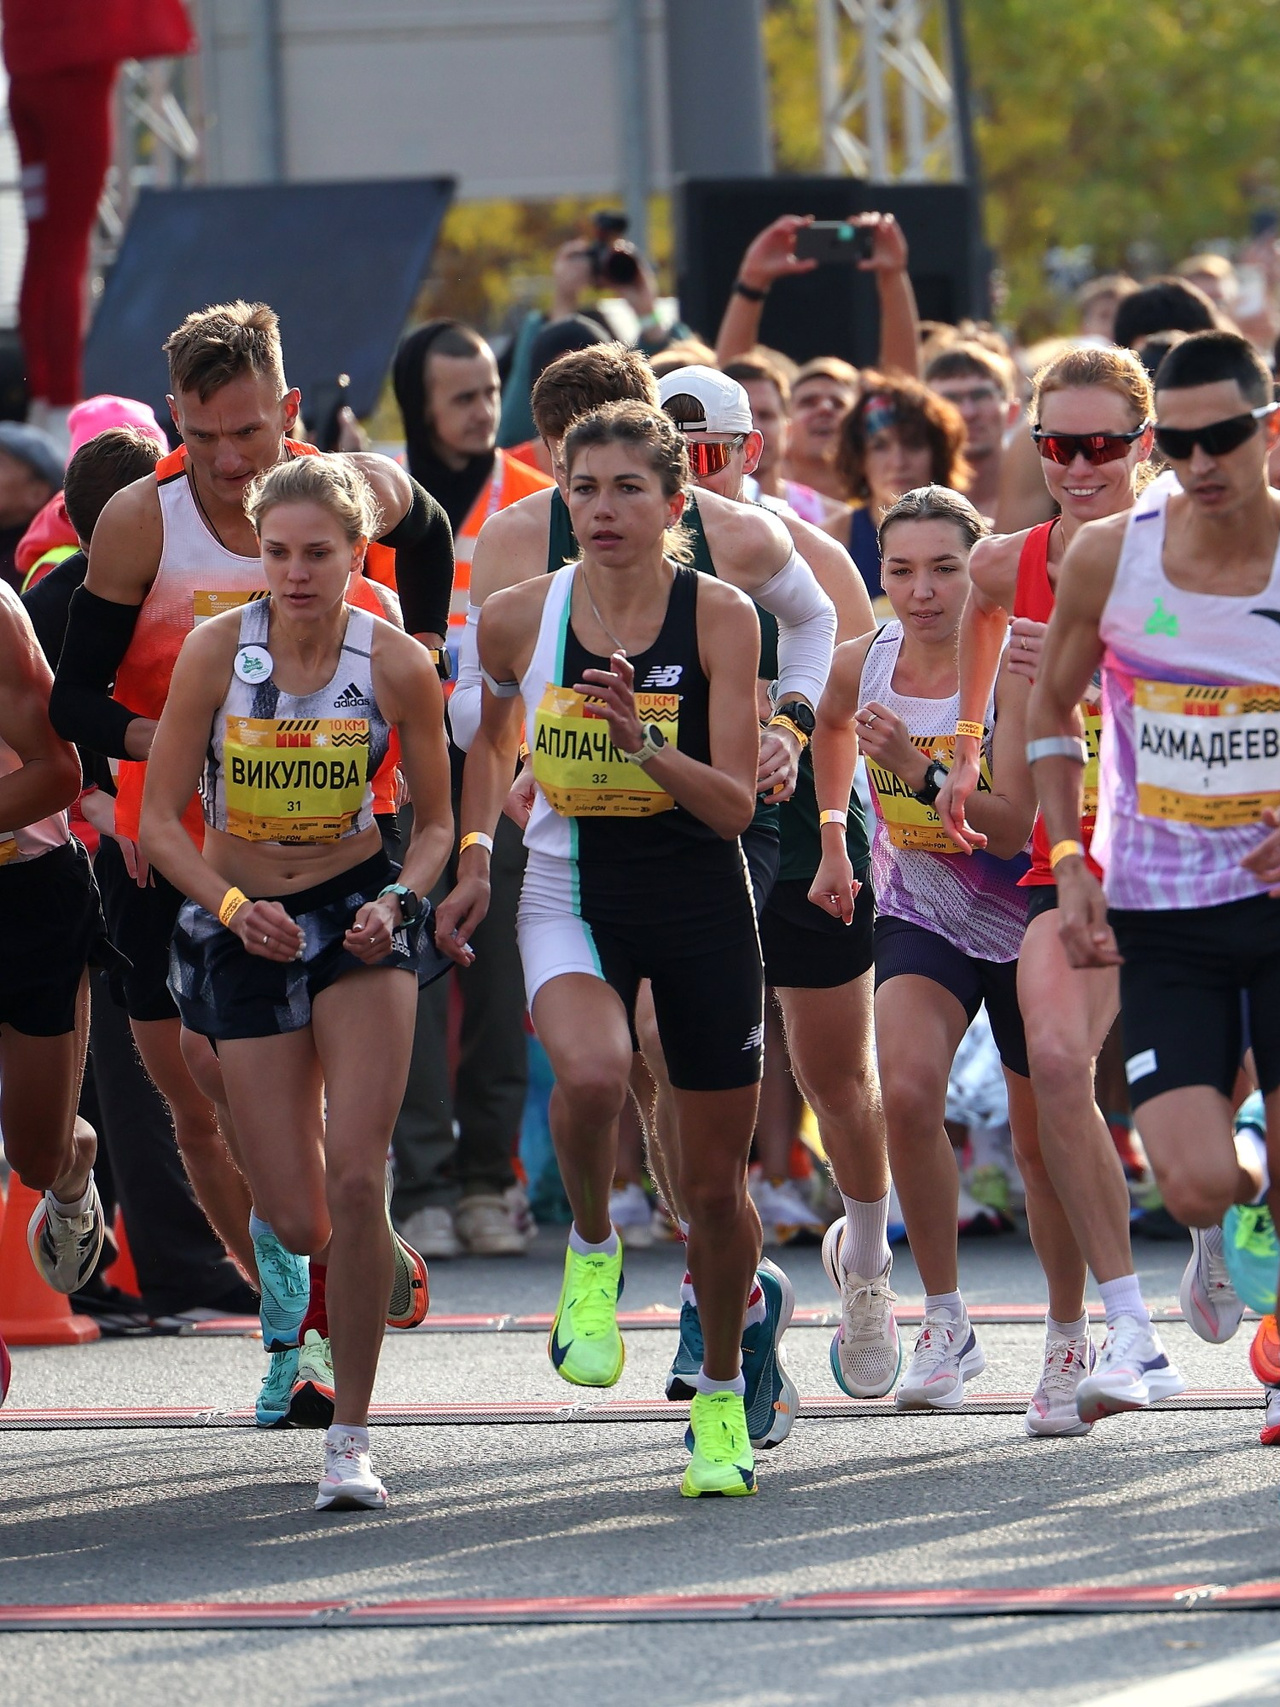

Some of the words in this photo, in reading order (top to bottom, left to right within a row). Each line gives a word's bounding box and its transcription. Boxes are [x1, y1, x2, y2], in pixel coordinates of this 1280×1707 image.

[334, 697, 370, 708] adidas
[639, 695, 649, 706] 10
[329, 720, 341, 730] 10
[535, 724, 669, 764] АПЛАЧК
[945, 736, 955, 746] 10
[1140, 722, 1280, 769] АХМАДЕЕВ
[231, 756, 360, 790] ВИКУЛОВА
[592, 774, 608, 784] 32
[287, 801, 301, 812] 31
[926, 811, 940, 821] 34
[391, 939, 410, 957] didas
